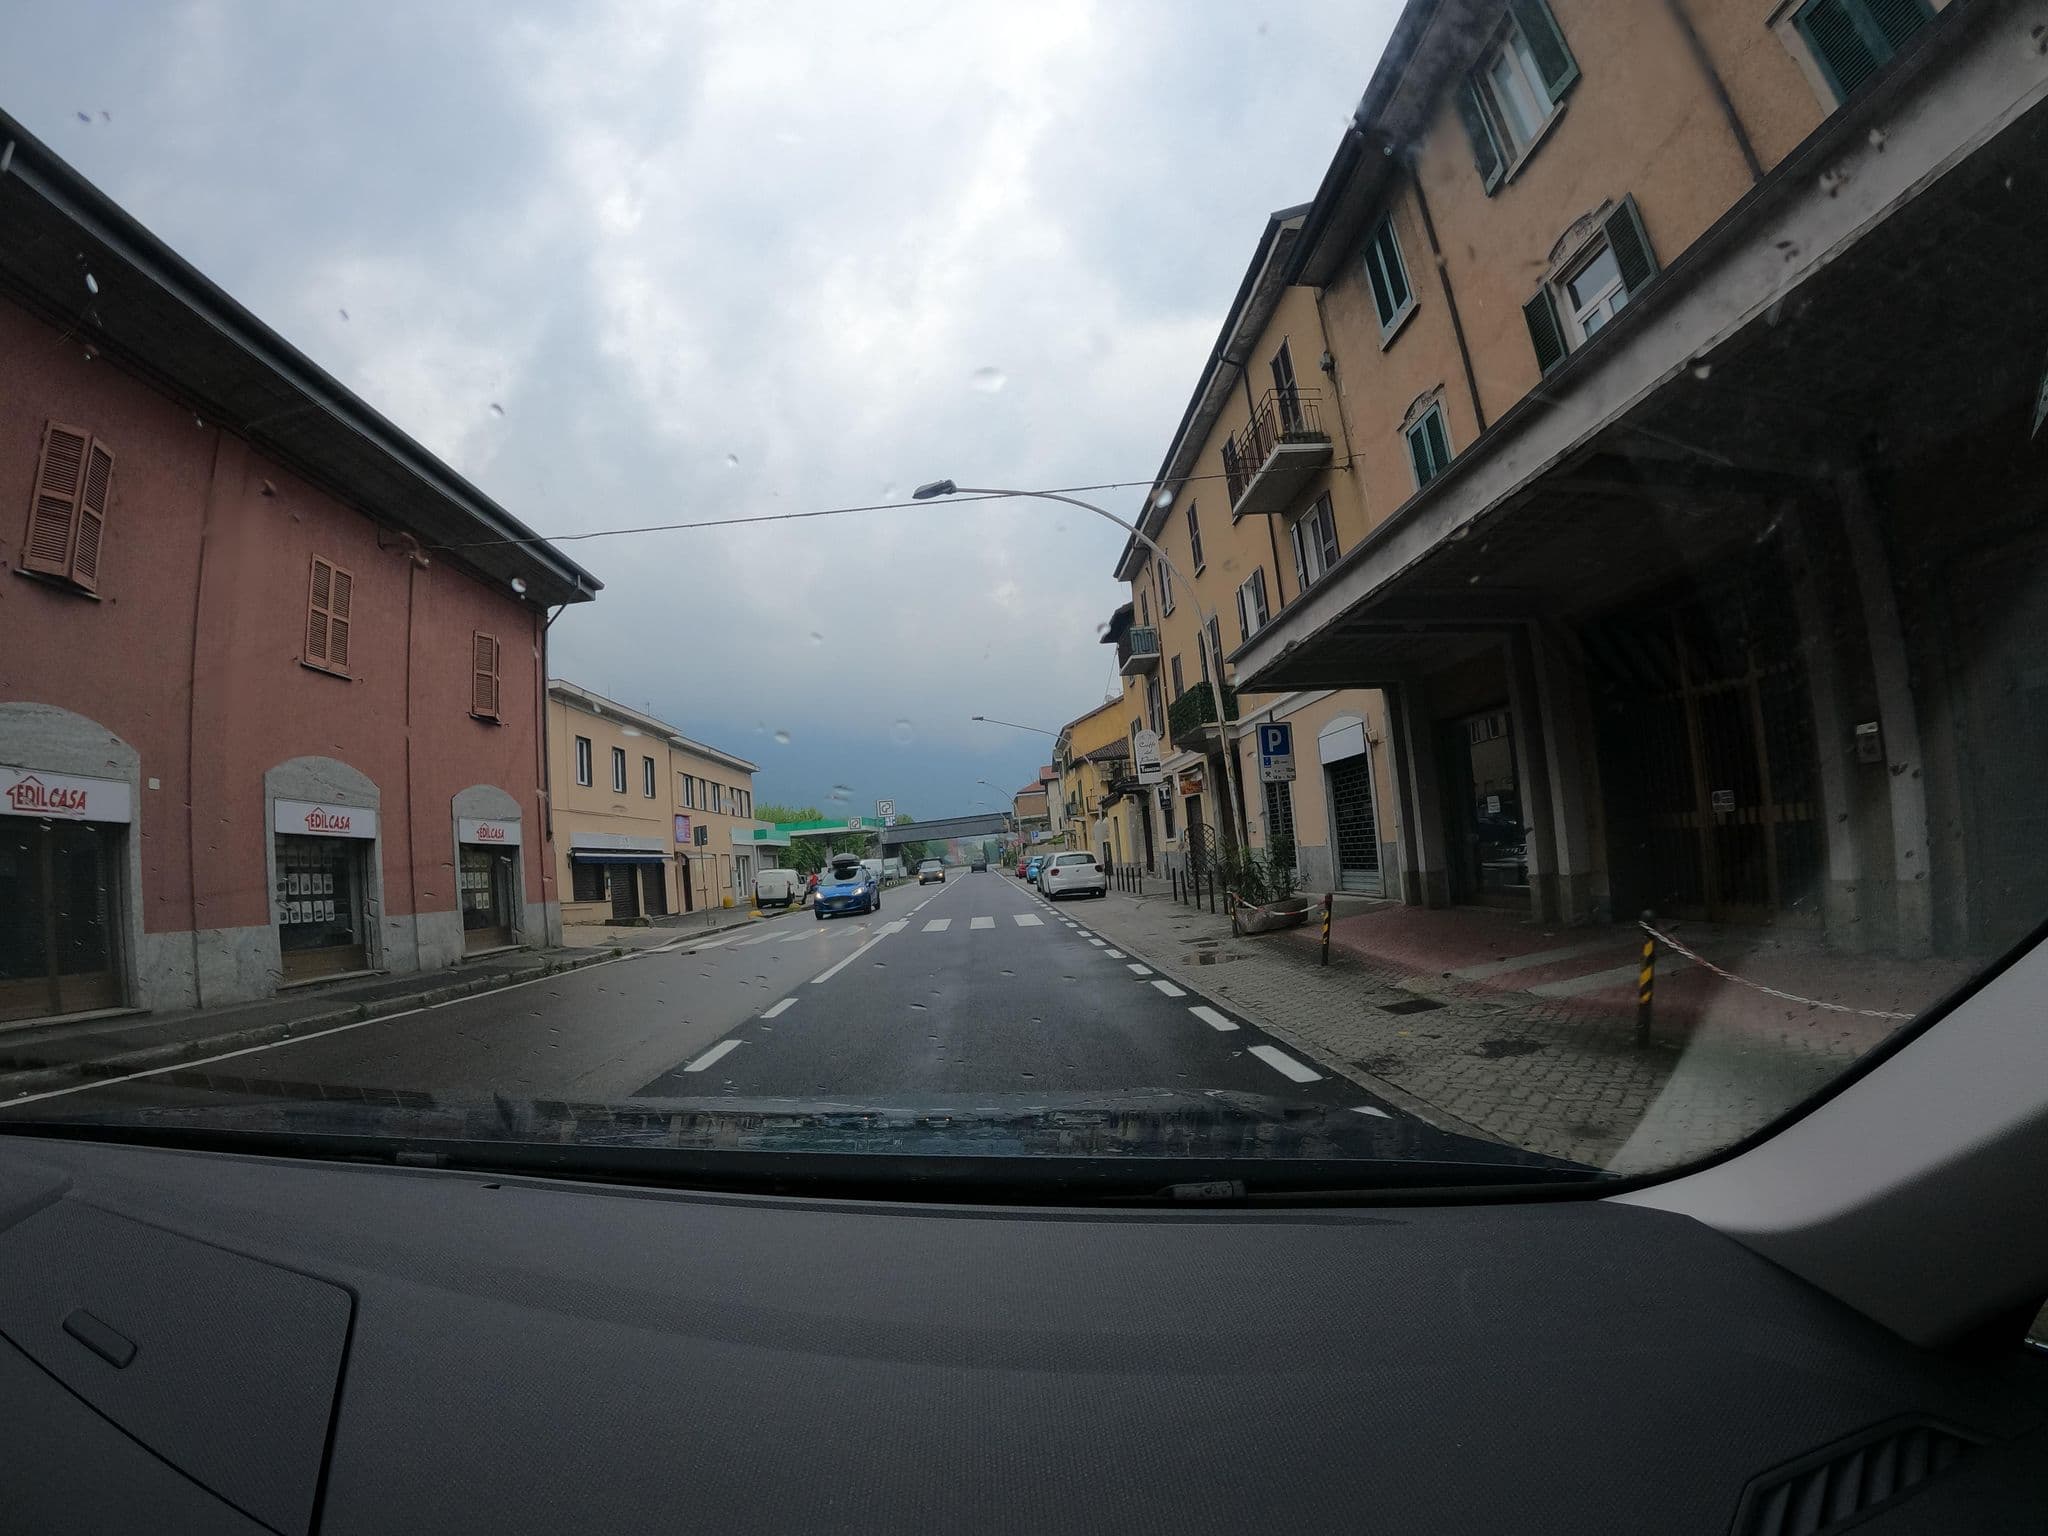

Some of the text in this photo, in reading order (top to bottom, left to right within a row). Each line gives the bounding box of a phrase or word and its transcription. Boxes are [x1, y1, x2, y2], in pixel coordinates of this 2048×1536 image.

[1267, 729, 1282, 752] P
[16, 784, 87, 810] EDILCASA
[310, 813, 351, 830] EDILCASA
